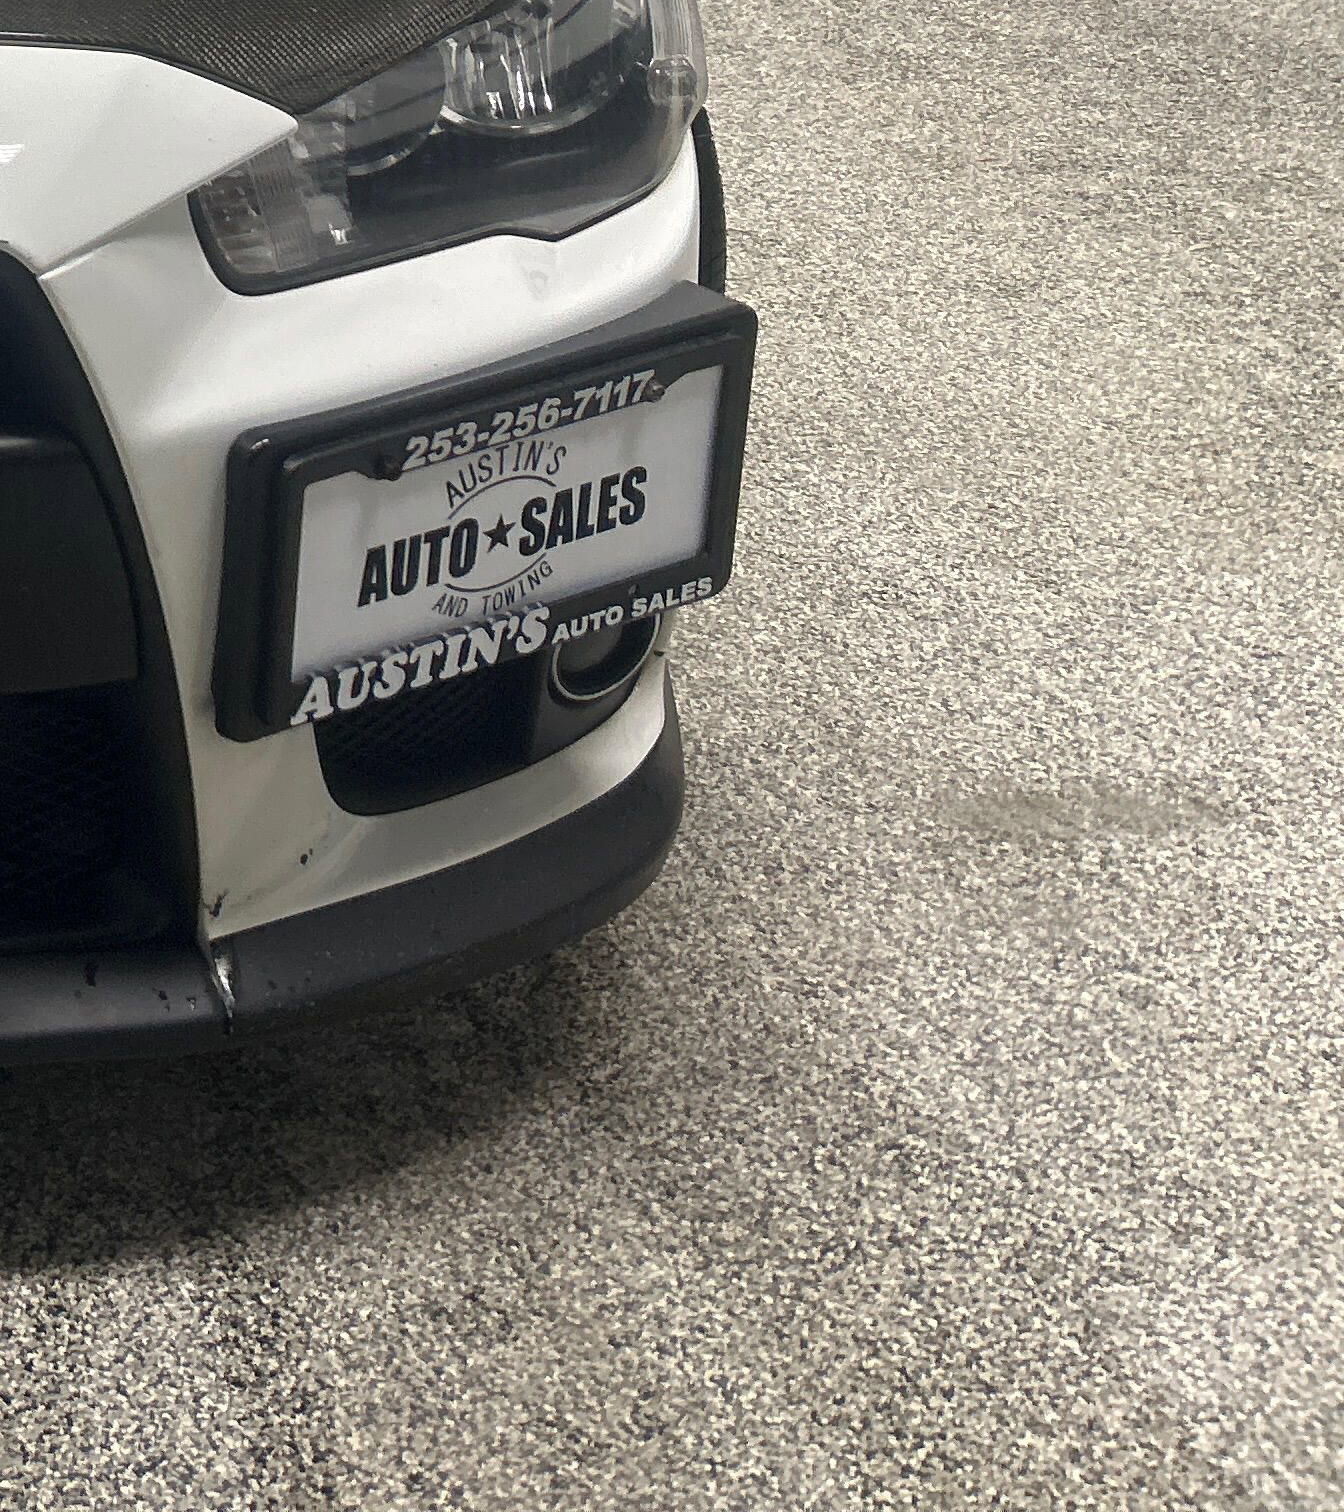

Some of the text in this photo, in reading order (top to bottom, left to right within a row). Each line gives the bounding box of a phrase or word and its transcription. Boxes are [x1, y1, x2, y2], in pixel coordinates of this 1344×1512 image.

[403, 369, 657, 470] 253-256-7117
[445, 439, 567, 508] AUSTIN'S
[357, 466, 648, 608] AUTO SALES
[290, 577, 714, 725] AUSTIN'S AUTO SALES
[431, 594, 469, 618] AND
